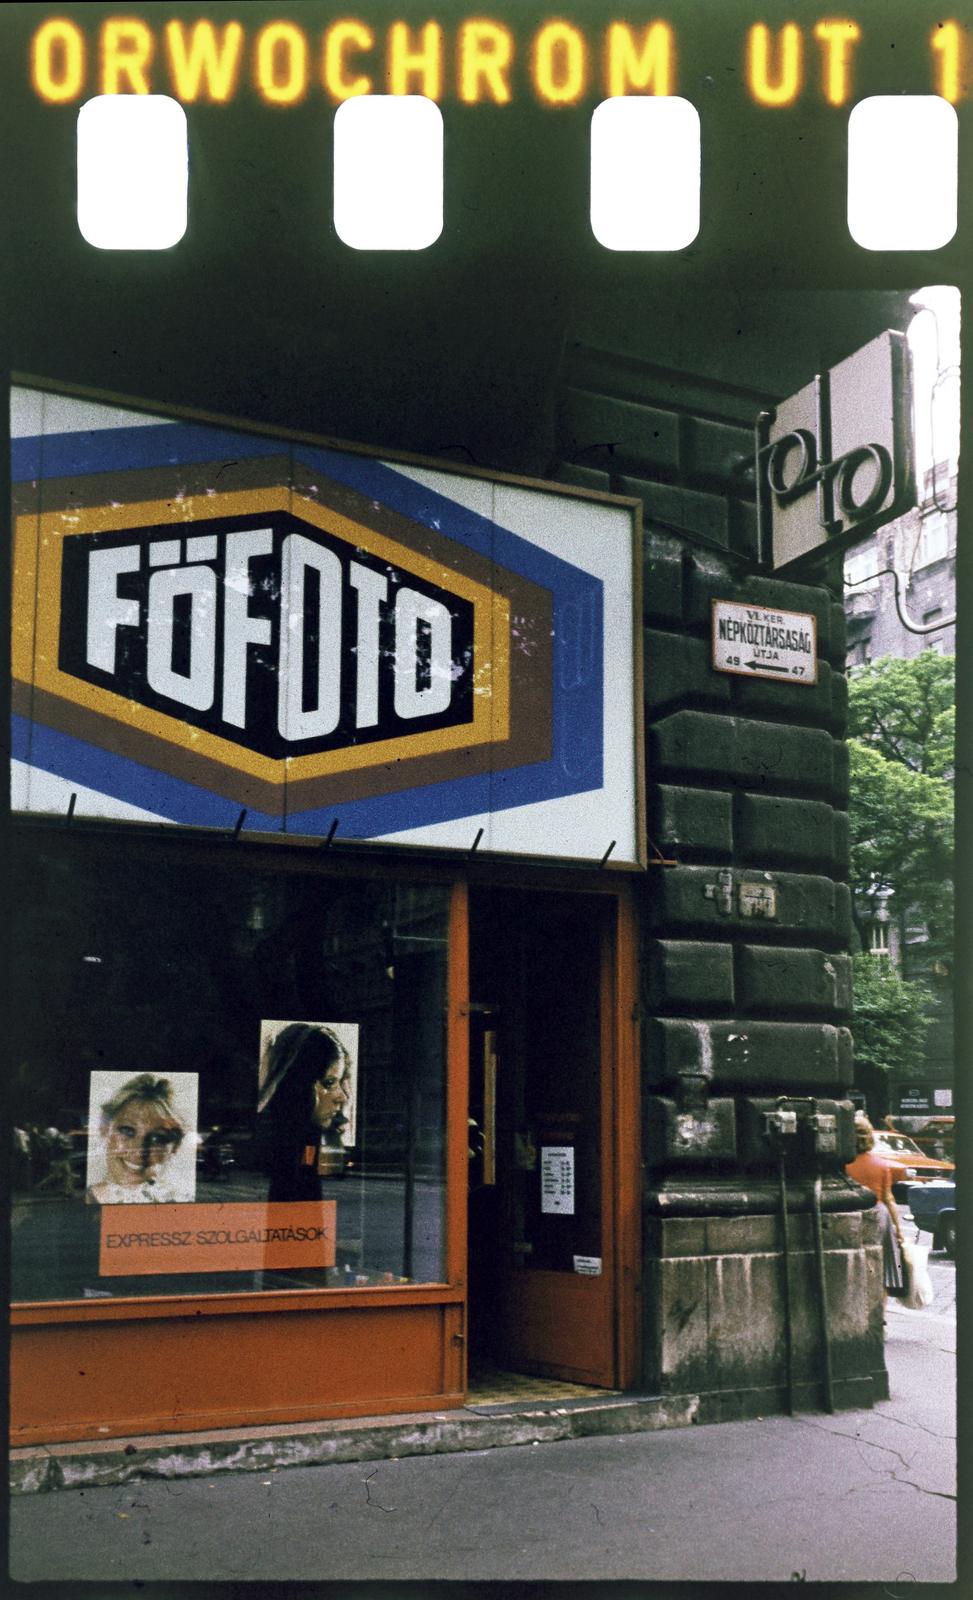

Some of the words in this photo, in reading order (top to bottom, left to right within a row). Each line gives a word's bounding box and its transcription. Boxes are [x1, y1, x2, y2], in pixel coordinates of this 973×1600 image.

[32, 20, 678, 104] ORWOCHROM
[747, 22, 861, 106] UT
[725, 655, 740, 666] 49
[791, 665, 805, 676] 47
[106, 1231, 191, 1249] EXPRESSZ
